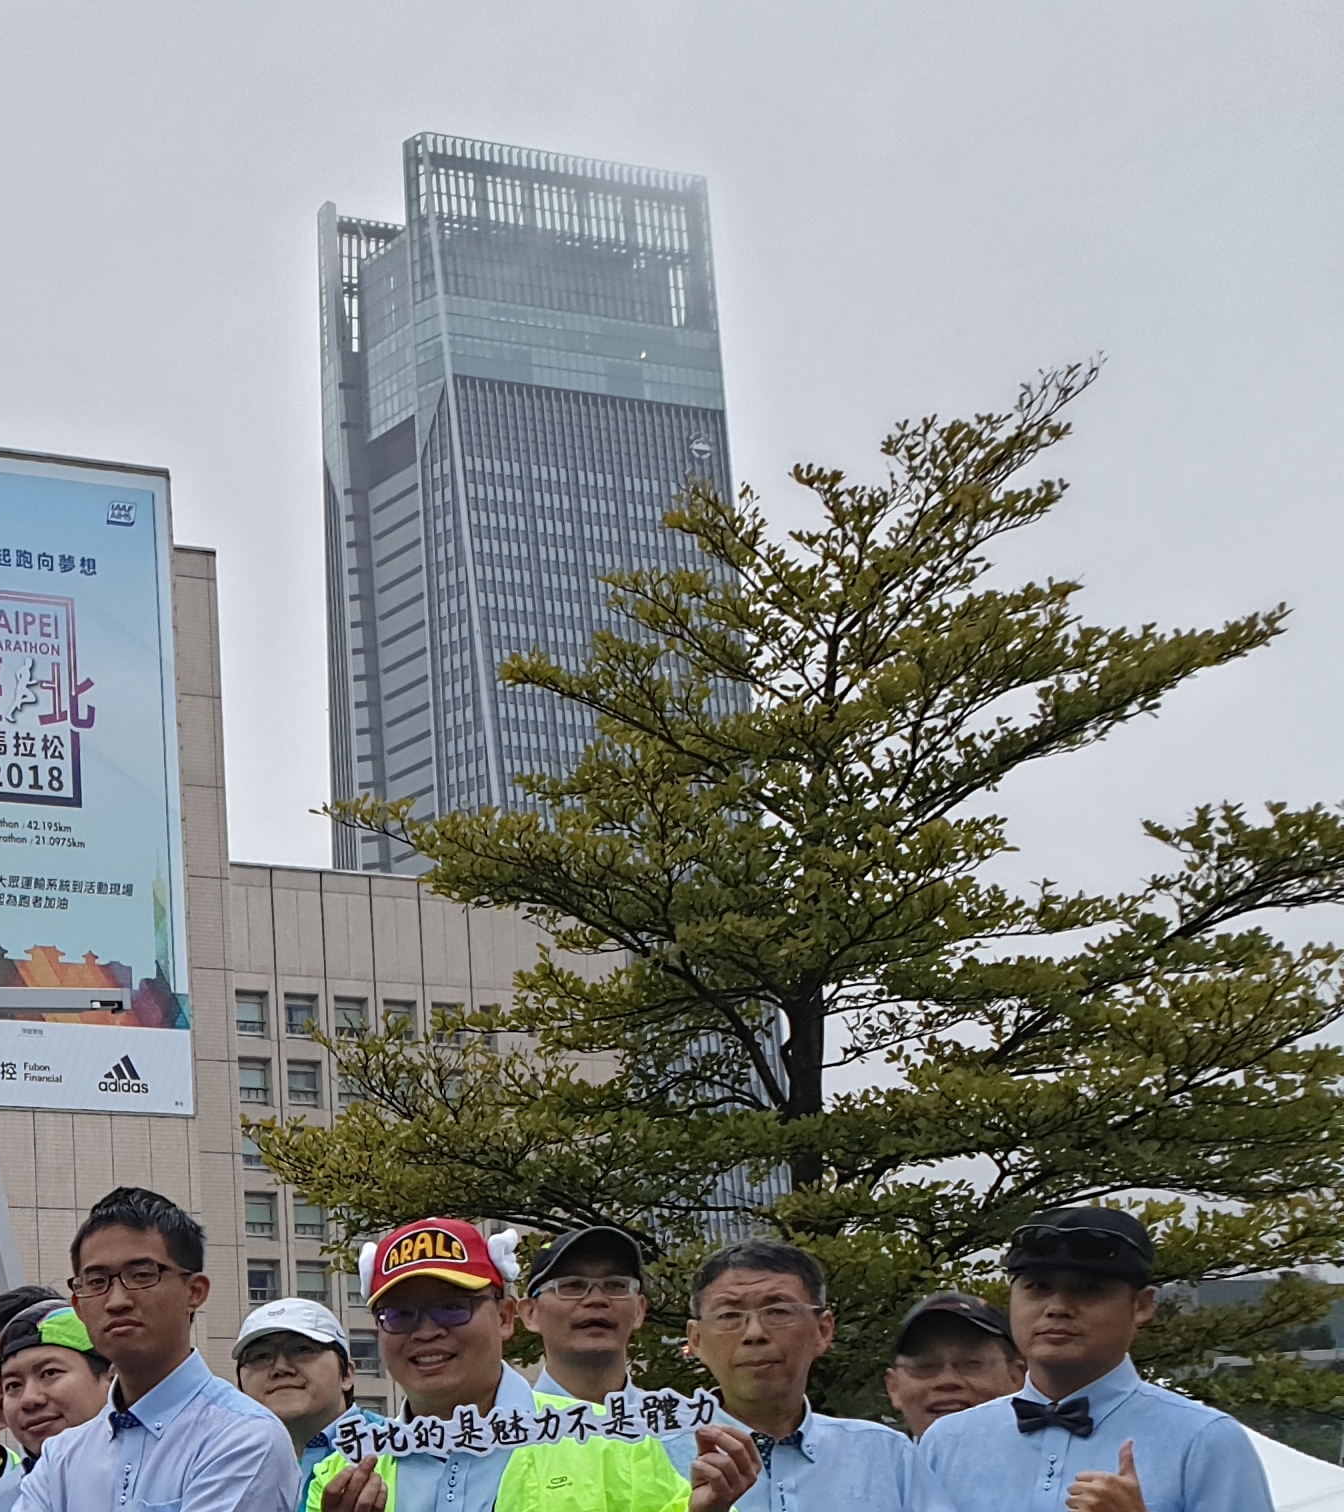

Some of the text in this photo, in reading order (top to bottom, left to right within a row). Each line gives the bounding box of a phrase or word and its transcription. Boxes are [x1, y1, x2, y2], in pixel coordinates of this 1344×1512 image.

[27, 820, 72, 833] 42.195km
[24, 1062, 50, 1072] Fubon
[24, 1073, 62, 1083] Financial
[98, 1080, 149, 1094] adidas
[389, 1232, 463, 1268] ARALE
